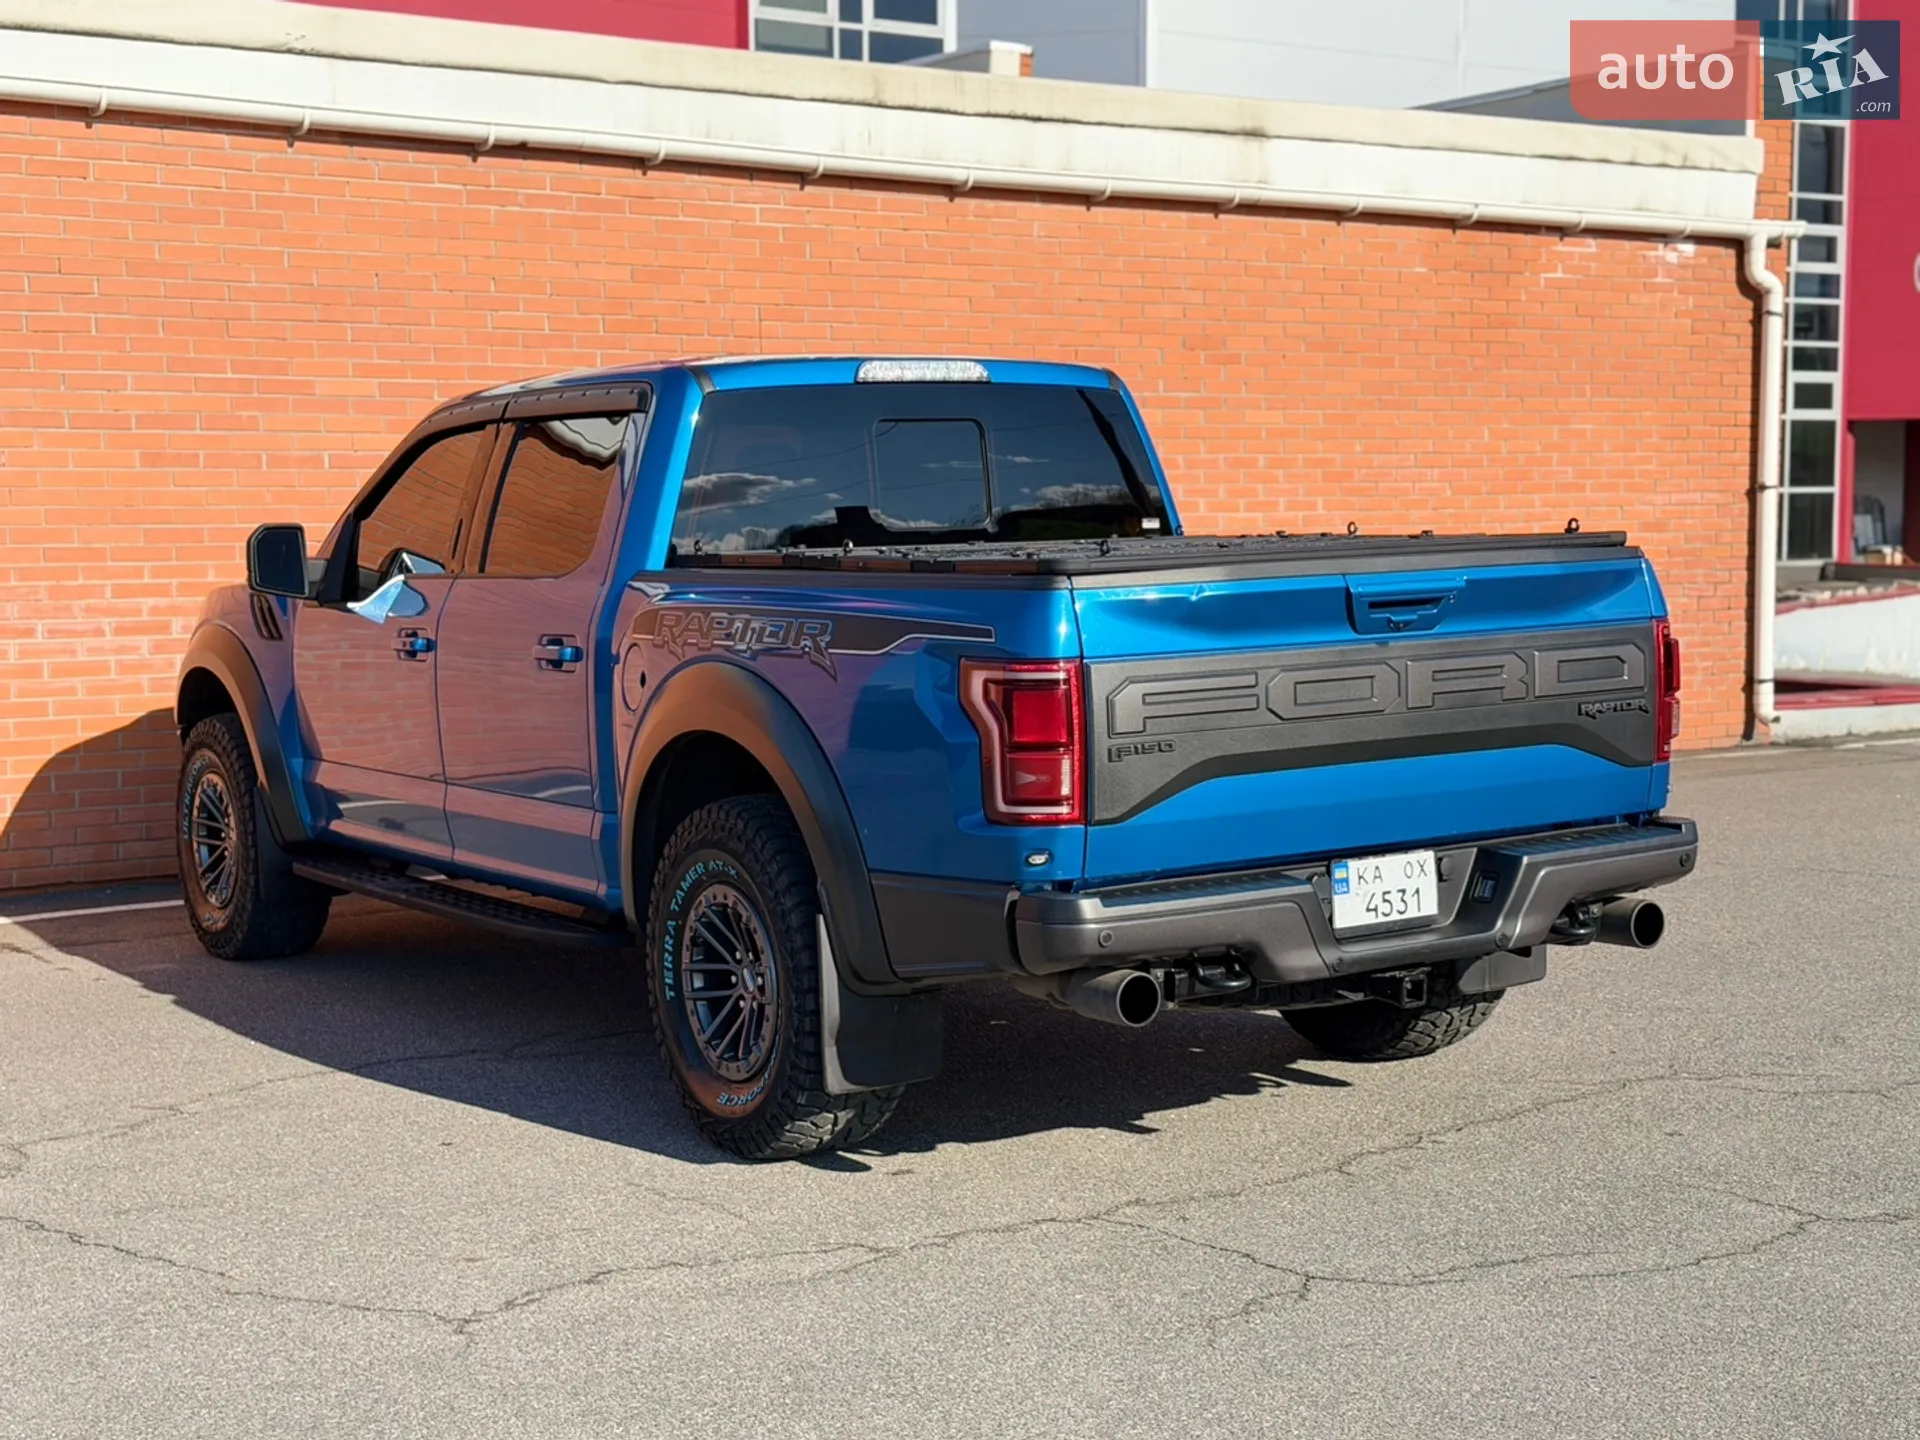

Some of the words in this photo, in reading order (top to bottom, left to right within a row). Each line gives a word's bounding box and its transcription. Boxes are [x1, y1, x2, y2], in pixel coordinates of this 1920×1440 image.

[654, 610, 838, 683] RAPTOR
[1107, 641, 1647, 740] FORD
[1577, 698, 1650, 720] RAPTOR
[670, 860, 706, 913] TAMER
[1335, 882, 1348, 893] UA
[1356, 865, 1384, 886] KA
[1365, 886, 1422, 919] 4531
[664, 919, 677, 1002] TERRA
